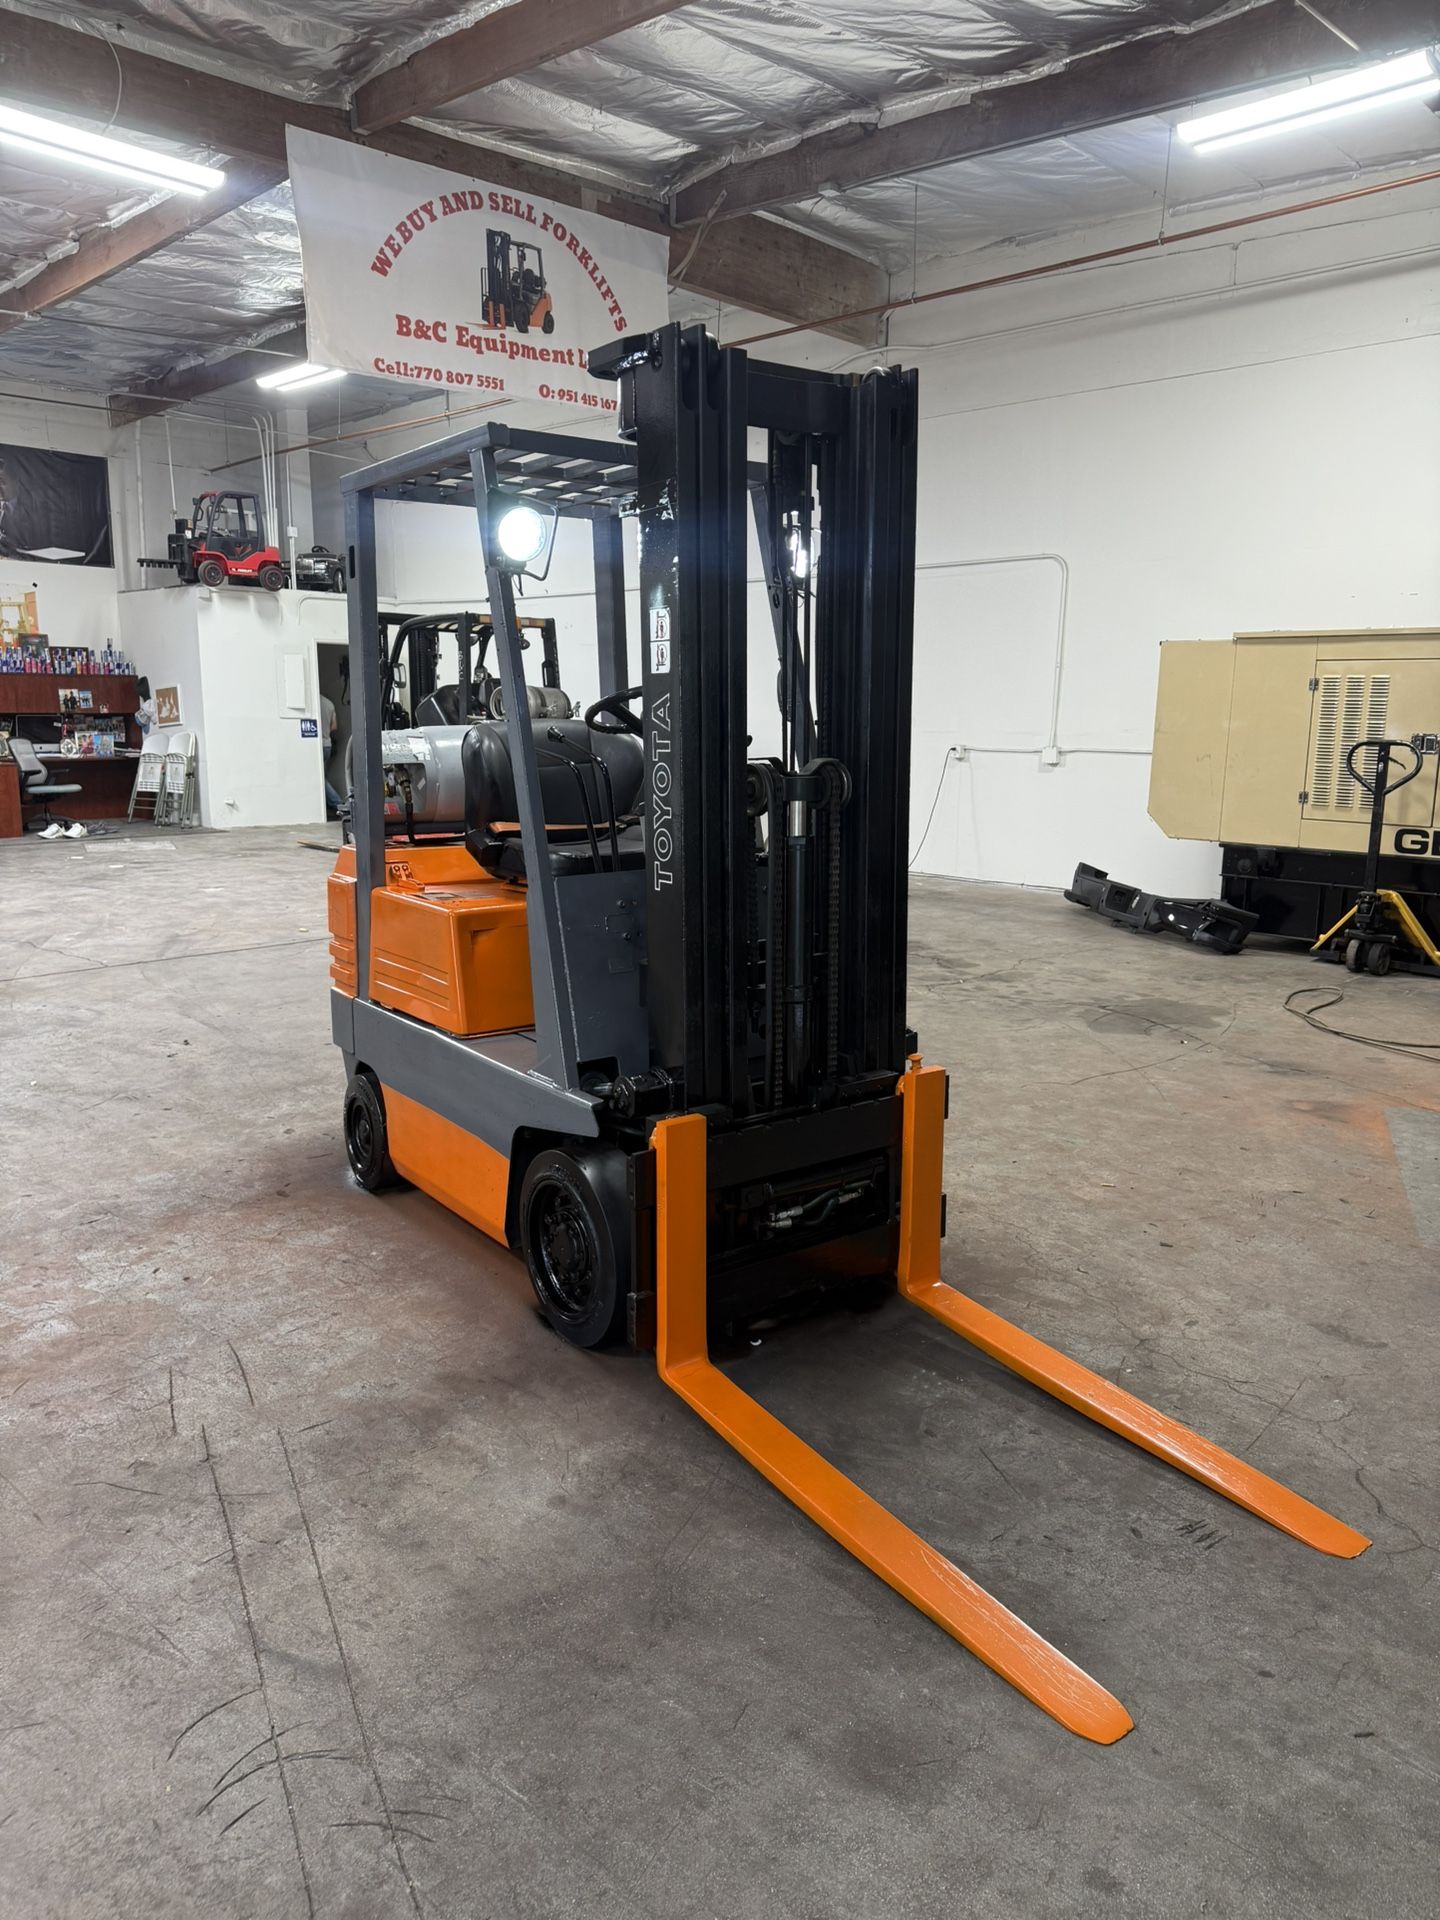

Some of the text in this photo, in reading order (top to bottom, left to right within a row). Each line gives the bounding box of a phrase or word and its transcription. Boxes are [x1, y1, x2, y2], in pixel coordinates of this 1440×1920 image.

[371, 190, 627, 332] WE BUY AND SELL FORKLIFTS
[395, 313, 588, 369] B&C Equipment L
[446, 370, 473, 386] 807
[477, 374, 504, 391] 5551
[538, 384, 556, 399] O:
[557, 388, 578, 402] 951
[581, 392, 598, 407] 415
[652, 692, 672, 891] TOYOTA
[1394, 828, 1440, 856] G
